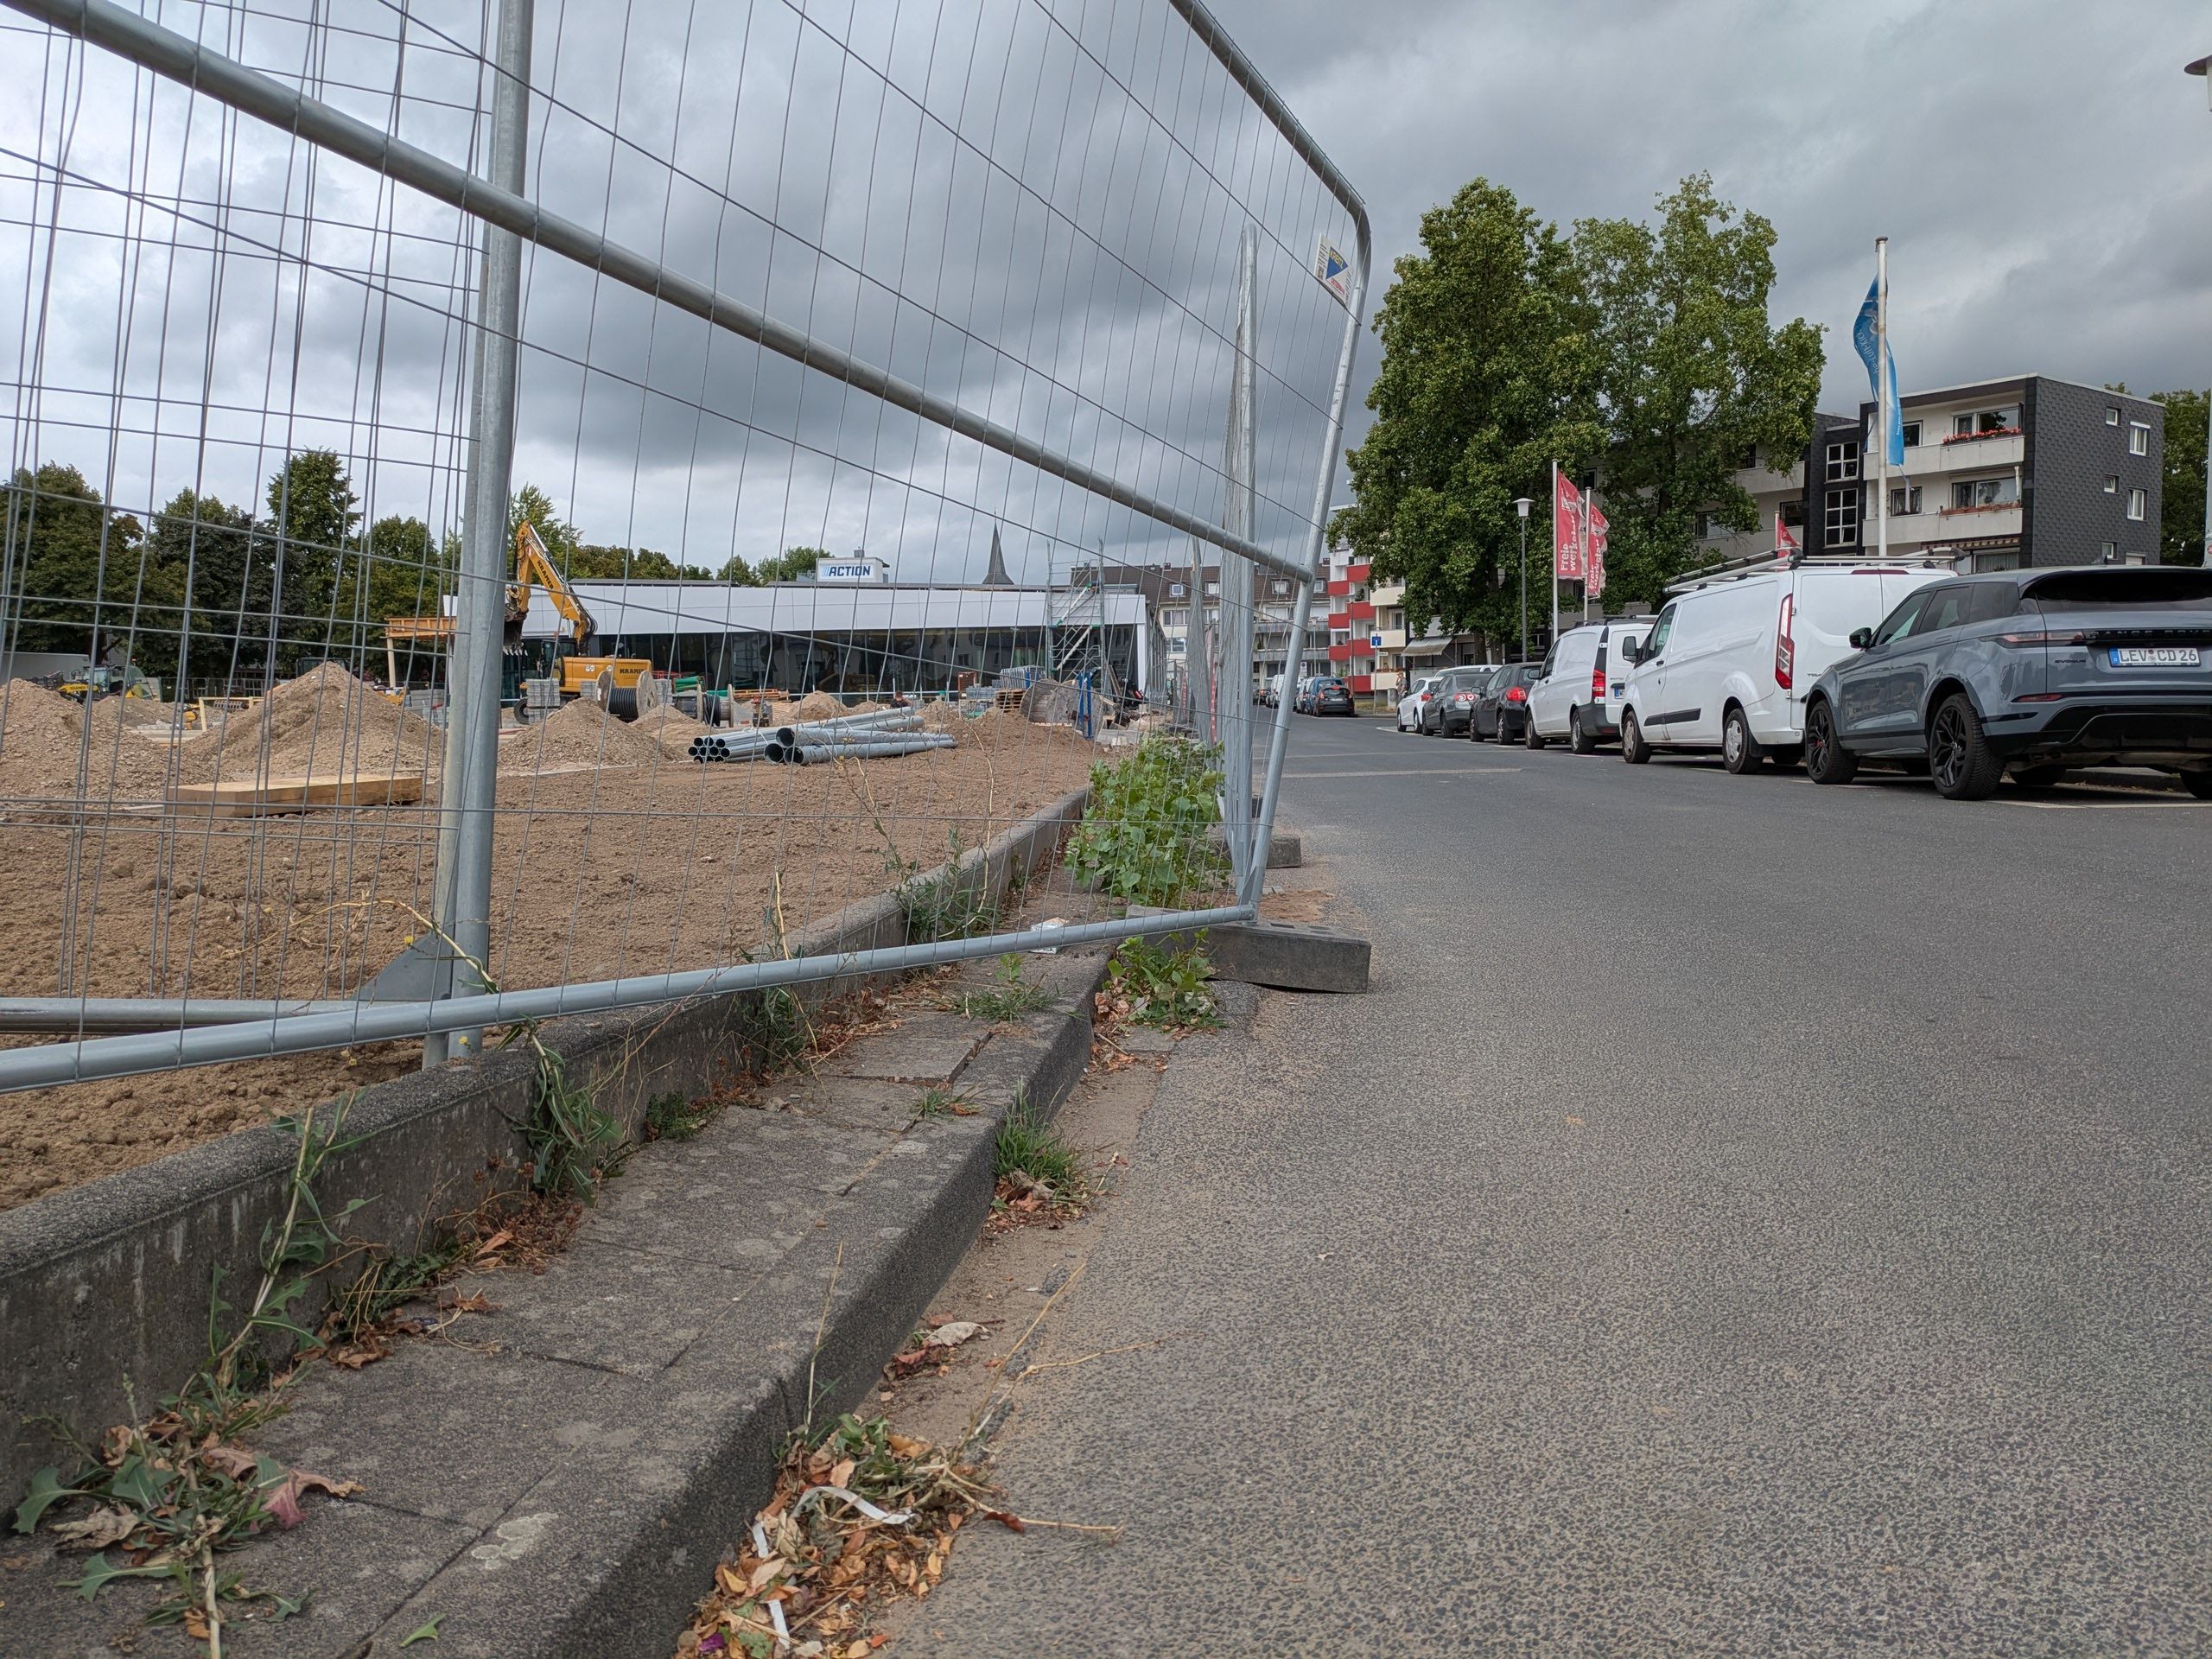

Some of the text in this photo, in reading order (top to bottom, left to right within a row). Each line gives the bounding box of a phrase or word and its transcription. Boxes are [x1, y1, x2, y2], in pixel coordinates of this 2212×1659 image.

[537, 560, 554, 589] KRAMER
[829, 566, 871, 576] ACTION
[2120, 649, 2197, 662] LEV CD 26
